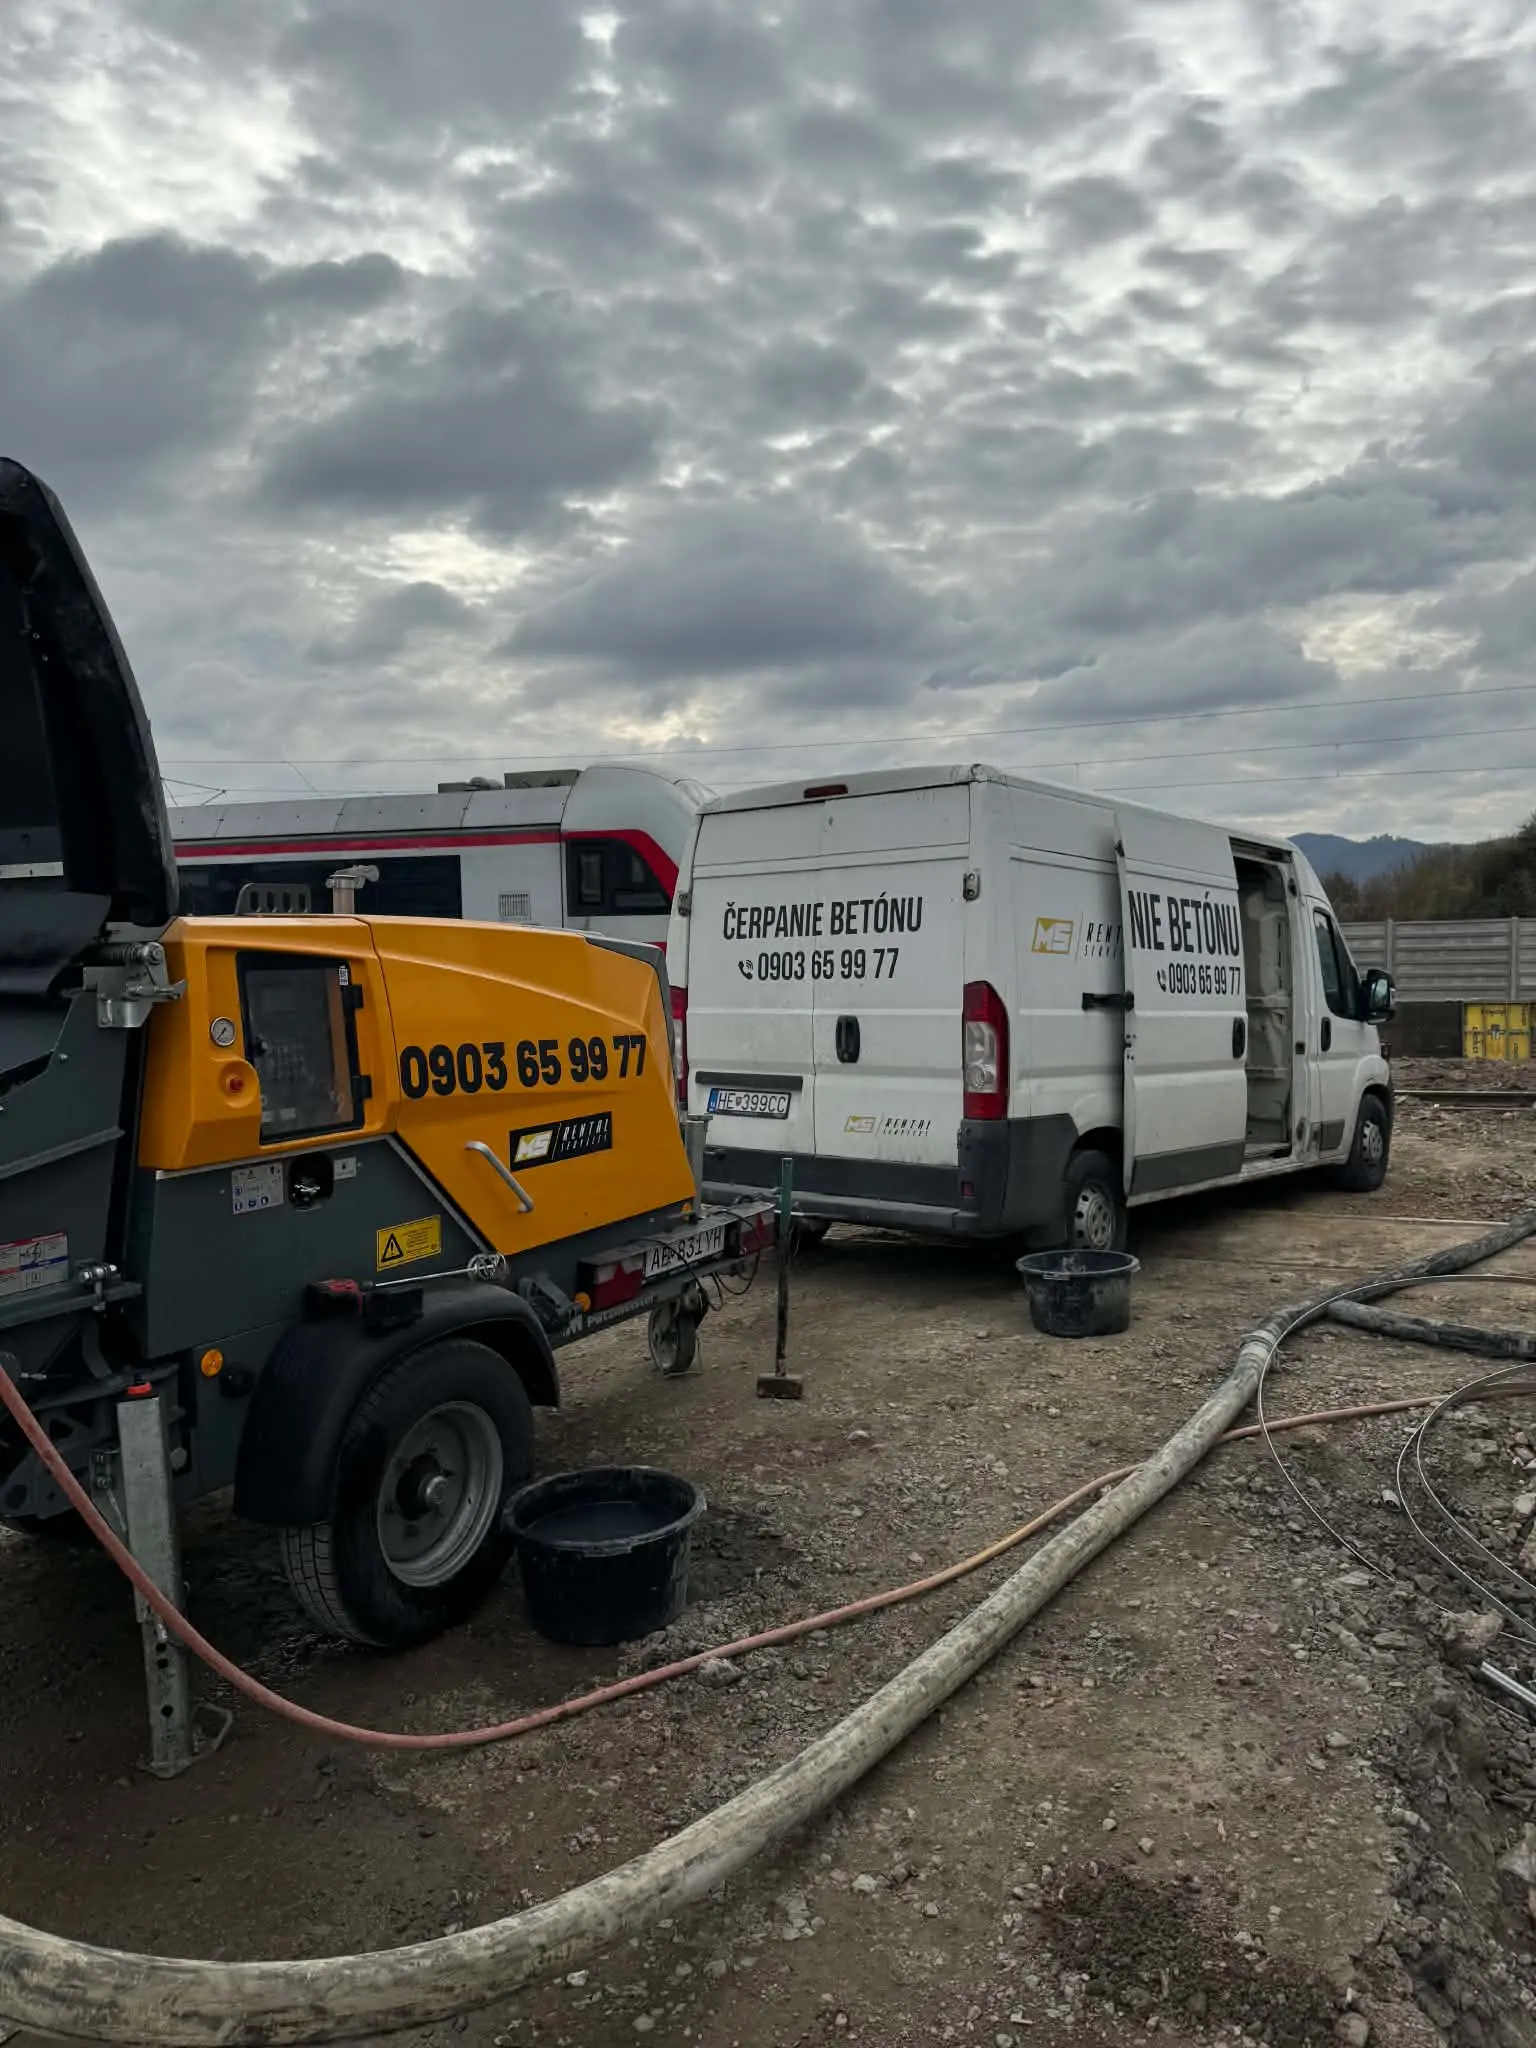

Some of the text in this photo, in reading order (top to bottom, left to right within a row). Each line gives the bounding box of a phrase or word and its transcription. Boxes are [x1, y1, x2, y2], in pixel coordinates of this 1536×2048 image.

[723, 891, 923, 940] ČERPANIE BETÓNU
[1128, 890, 1240, 956] NIE BETÓNU
[757, 947, 899, 980] 0903 65 99 77
[1168, 963, 1241, 996] 0903 65 99 77
[400, 1034, 647, 1099] 0903 65 99 77
